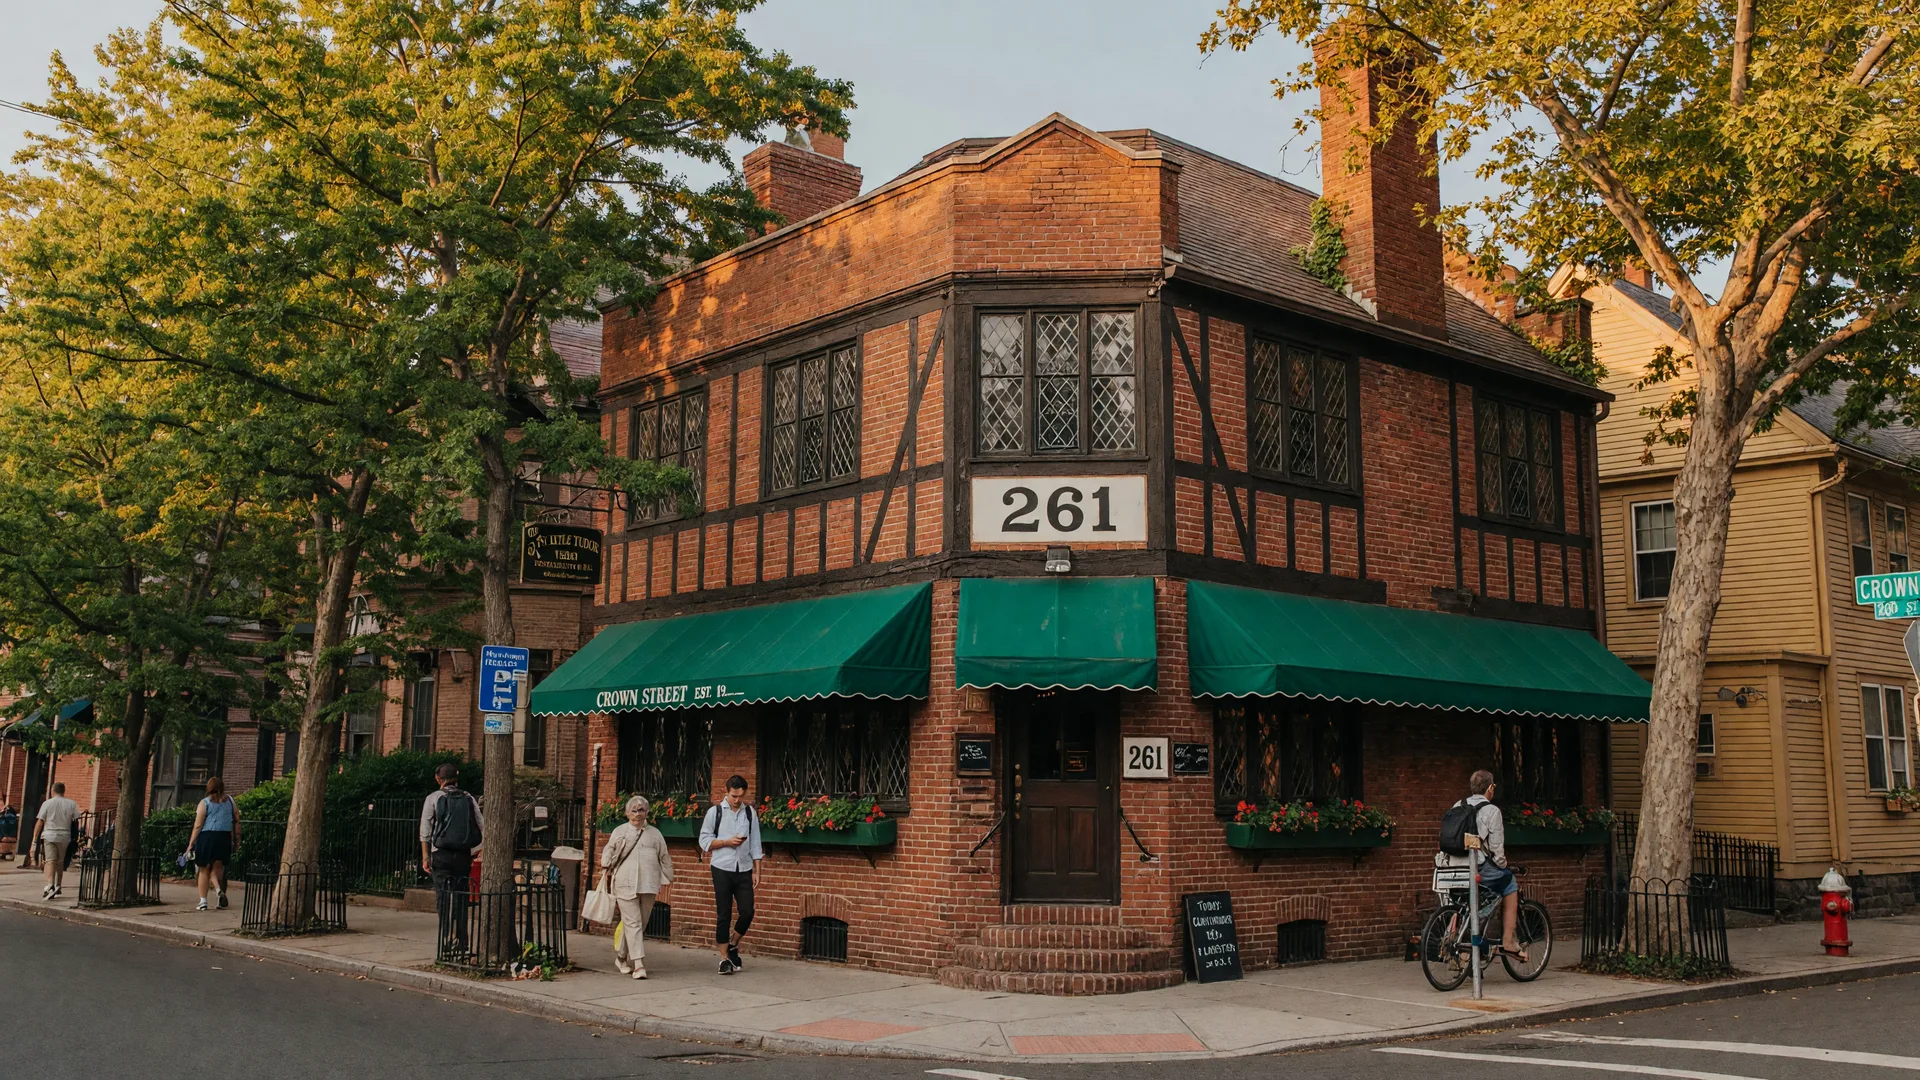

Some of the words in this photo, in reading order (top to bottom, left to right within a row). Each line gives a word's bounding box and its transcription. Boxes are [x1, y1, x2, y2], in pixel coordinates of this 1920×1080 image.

[1001, 486, 1117, 533] 261
[573, 534, 600, 554] TUDOR
[1860, 576, 1919, 600] CROWN
[596, 688, 639, 708] CROWN
[641, 685, 688, 705] STREET
[1128, 745, 1163, 770] 261
